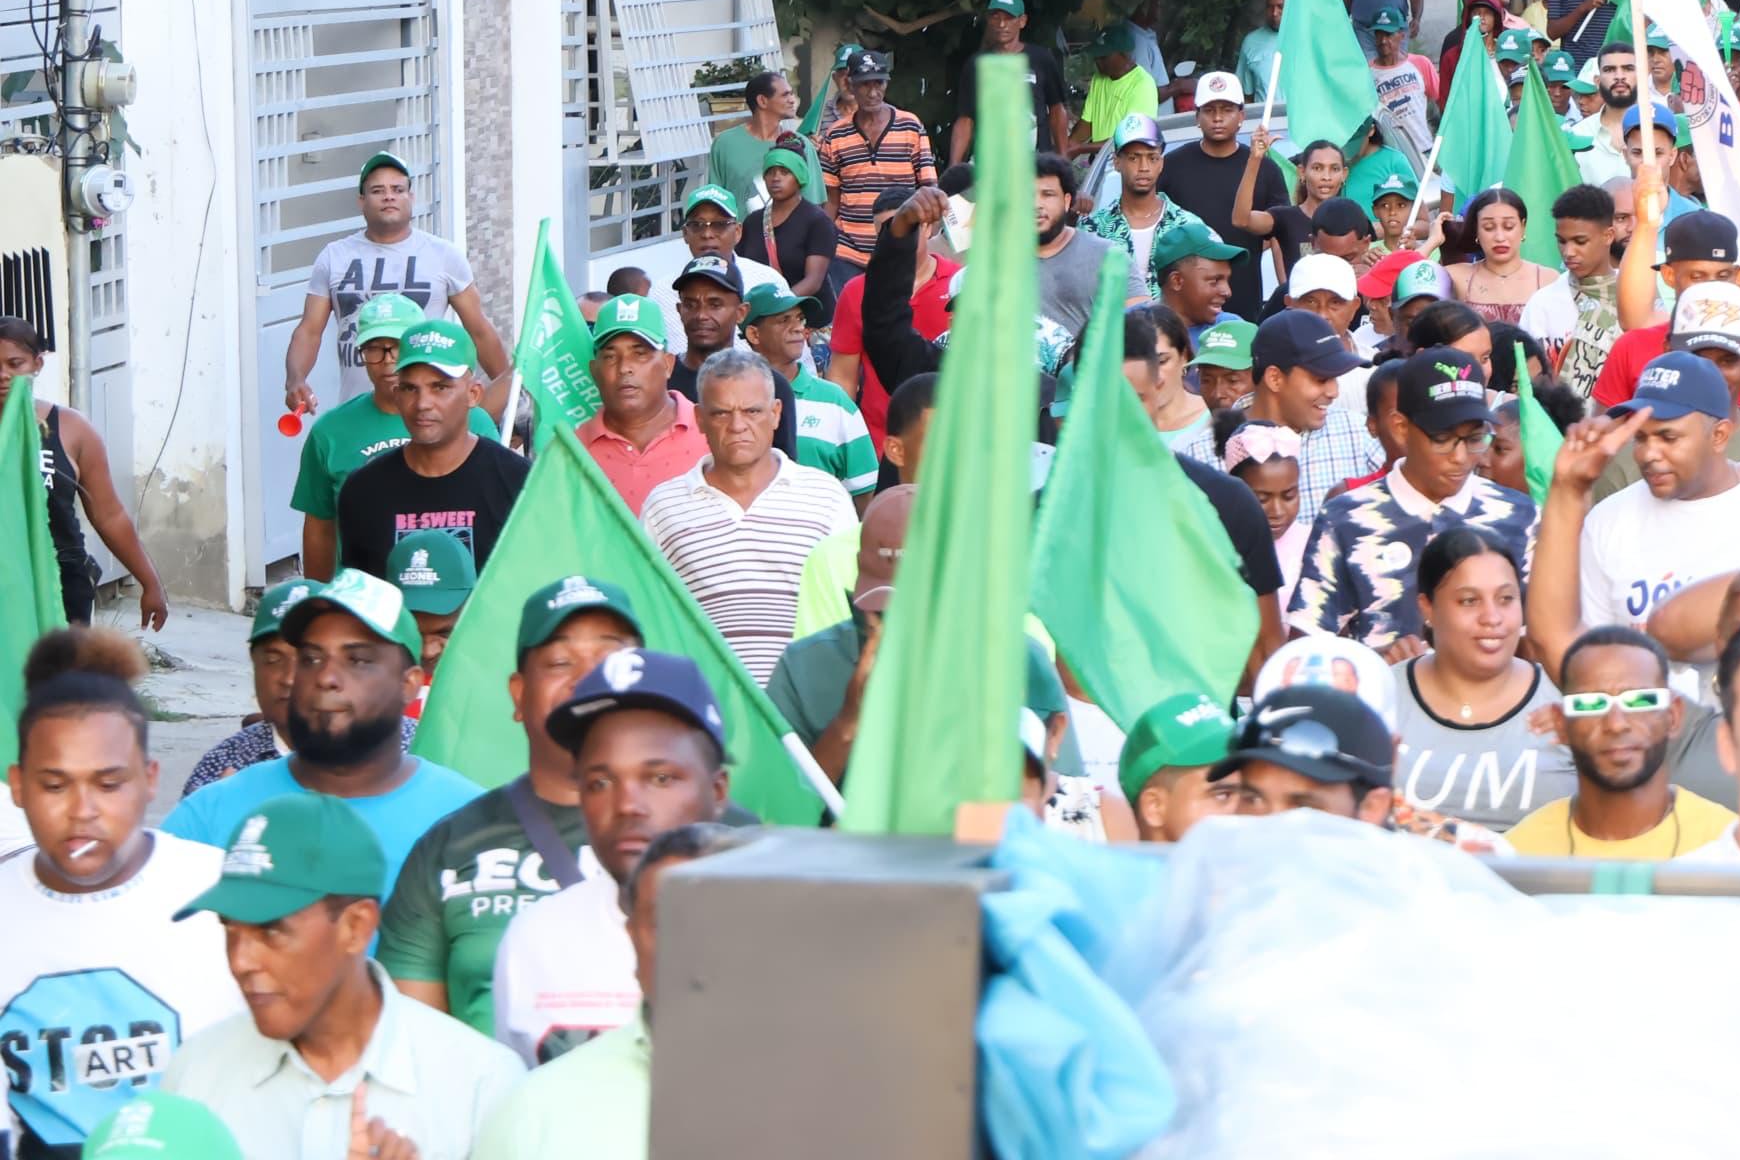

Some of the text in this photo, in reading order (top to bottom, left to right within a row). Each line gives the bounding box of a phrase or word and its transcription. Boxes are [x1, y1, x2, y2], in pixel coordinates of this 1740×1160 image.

[338, 255, 431, 291] ALL
[541, 366, 570, 406] DEL
[395, 510, 477, 531] BE SWEET
[399, 571, 441, 582] LEONEL
[1398, 744, 1538, 811] UM
[84, 1039, 159, 1078] ART
